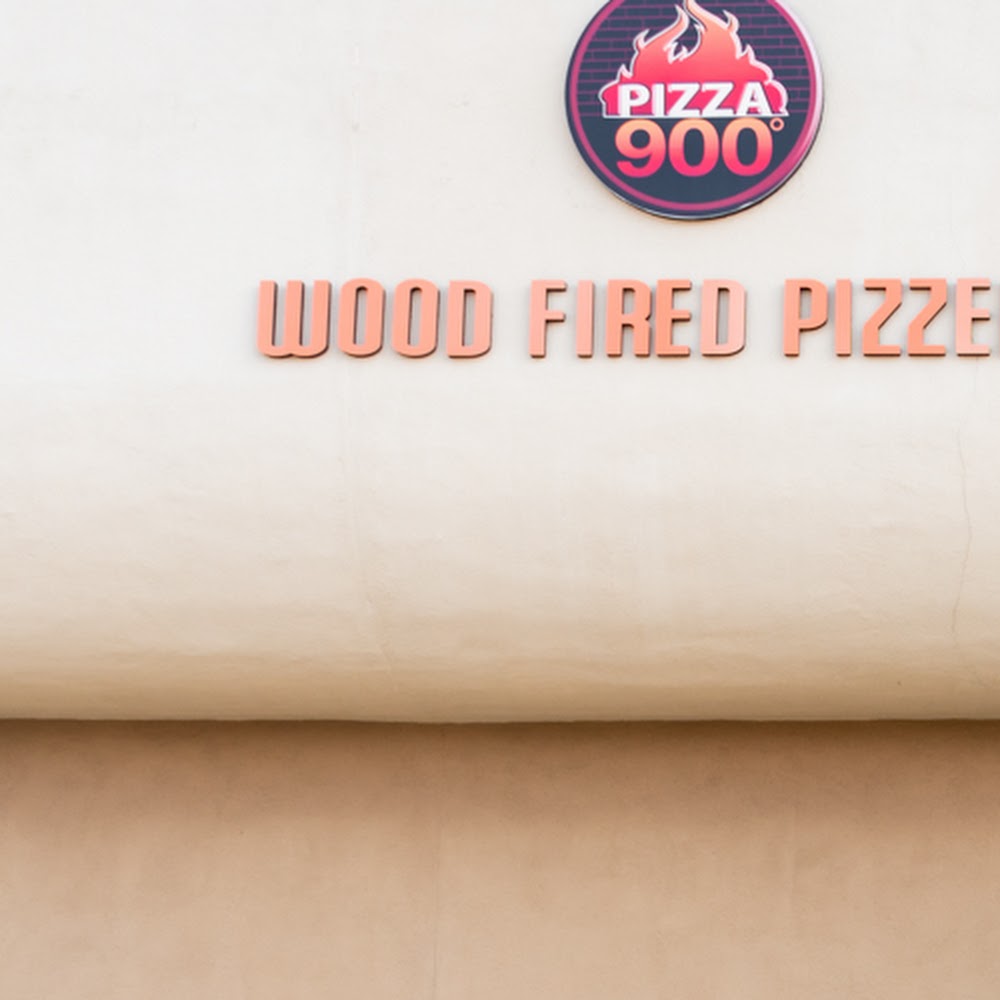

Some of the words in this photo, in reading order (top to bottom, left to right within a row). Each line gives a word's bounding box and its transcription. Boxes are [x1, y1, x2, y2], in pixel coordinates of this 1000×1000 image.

[617, 82, 772, 117] PIZZA
[257, 278, 493, 360] WOOD
[529, 279, 747, 359] FIRED
